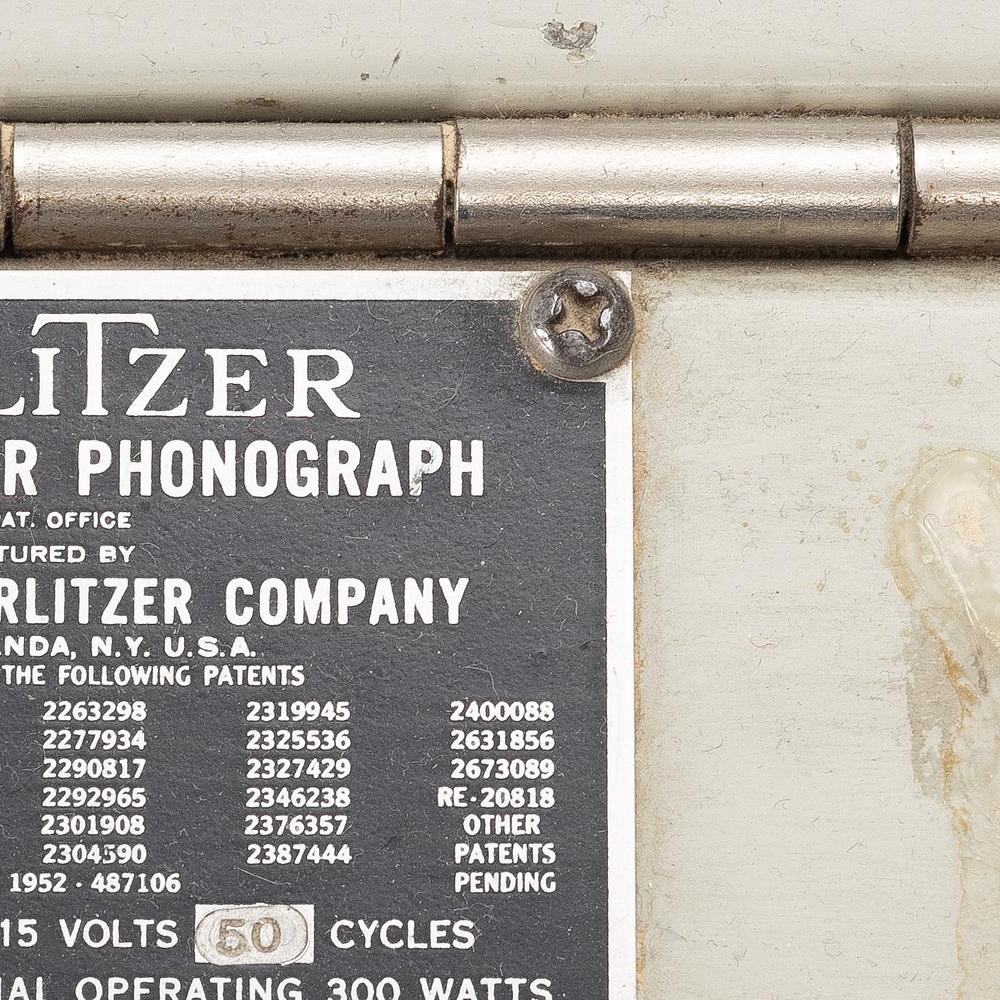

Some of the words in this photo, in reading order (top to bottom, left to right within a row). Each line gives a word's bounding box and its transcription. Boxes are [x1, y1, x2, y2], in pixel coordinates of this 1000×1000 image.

[77, 439, 484, 498] PHONOGRAPH
[46, 510, 132, 530] OFFICE
[99, 545, 136, 564] BY
[225, 577, 470, 626] COMPANY
[91, 635, 151, 658] N.Y.
[164, 635, 257, 658] U.S.A.
[1, 664, 46, 686] THE
[58, 664, 191, 687] FOLLOWING
[203, 664, 305, 687] PATENTS
[41, 700, 147, 722] 2263298
[246, 700, 351, 722] 2319945
[449, 700, 555, 722] 2400088
[42, 729, 147, 751] 2277934
[246, 729, 352, 751] 2325536
[450, 729, 556, 751] 2631856
[42, 756, 147, 779] 2290817
[246, 757, 352, 779] 2327429
[450, 757, 555, 780] 2673089
[42, 786, 147, 808] 2292965
[245, 786, 351, 809] 2346238
[40, 814, 146, 836] 2301908
[244, 814, 348, 836] 2376357
[462, 813, 541, 836] OTHER
[42, 843, 147, 865] 2304590
[246, 843, 353, 865] 2387444
[454, 842, 557, 865] PATENTS
[9, 872, 67, 894] 1952
[90, 872, 182, 894] 487106
[454, 871, 557, 893] PENDING
[58, 918, 179, 949] VOLTS
[216, 917, 281, 957] 50
[330, 918, 476, 950] CYCLES
